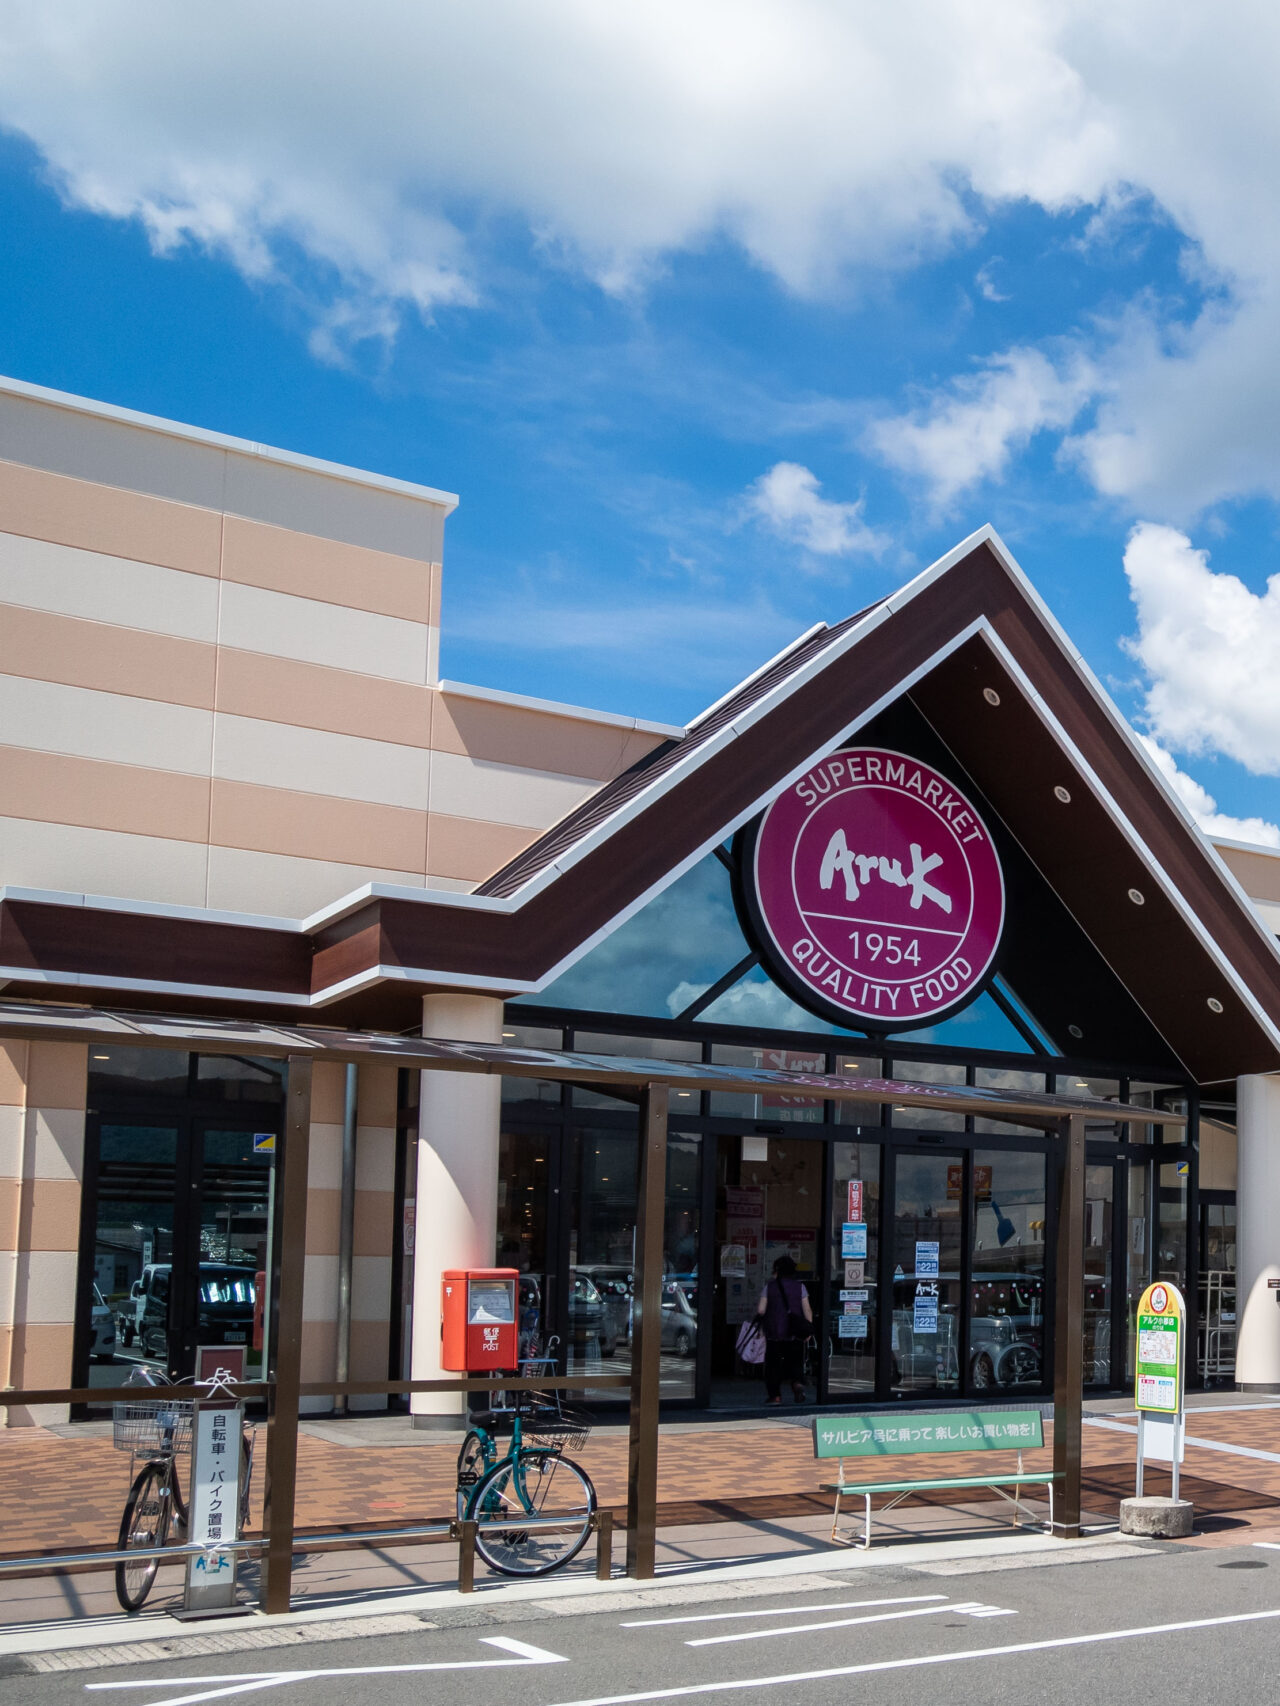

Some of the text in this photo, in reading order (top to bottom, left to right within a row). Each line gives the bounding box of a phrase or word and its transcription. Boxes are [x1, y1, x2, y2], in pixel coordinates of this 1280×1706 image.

[796, 757, 984, 844] SUPERMARKET
[849, 931, 922, 966] 1954
[792, 938, 972, 1010] QUALITY FOOD
[920, 1263, 931, 1272] 22
[919, 1317, 930, 1327] 22
[1143, 1316, 1174, 1325] アルク小郡店
[483, 1343, 499, 1351] POST
[822, 1427, 932, 1445] サルビア号に乗って
[207, 1415, 227, 1540] 自転車・バイク置場
